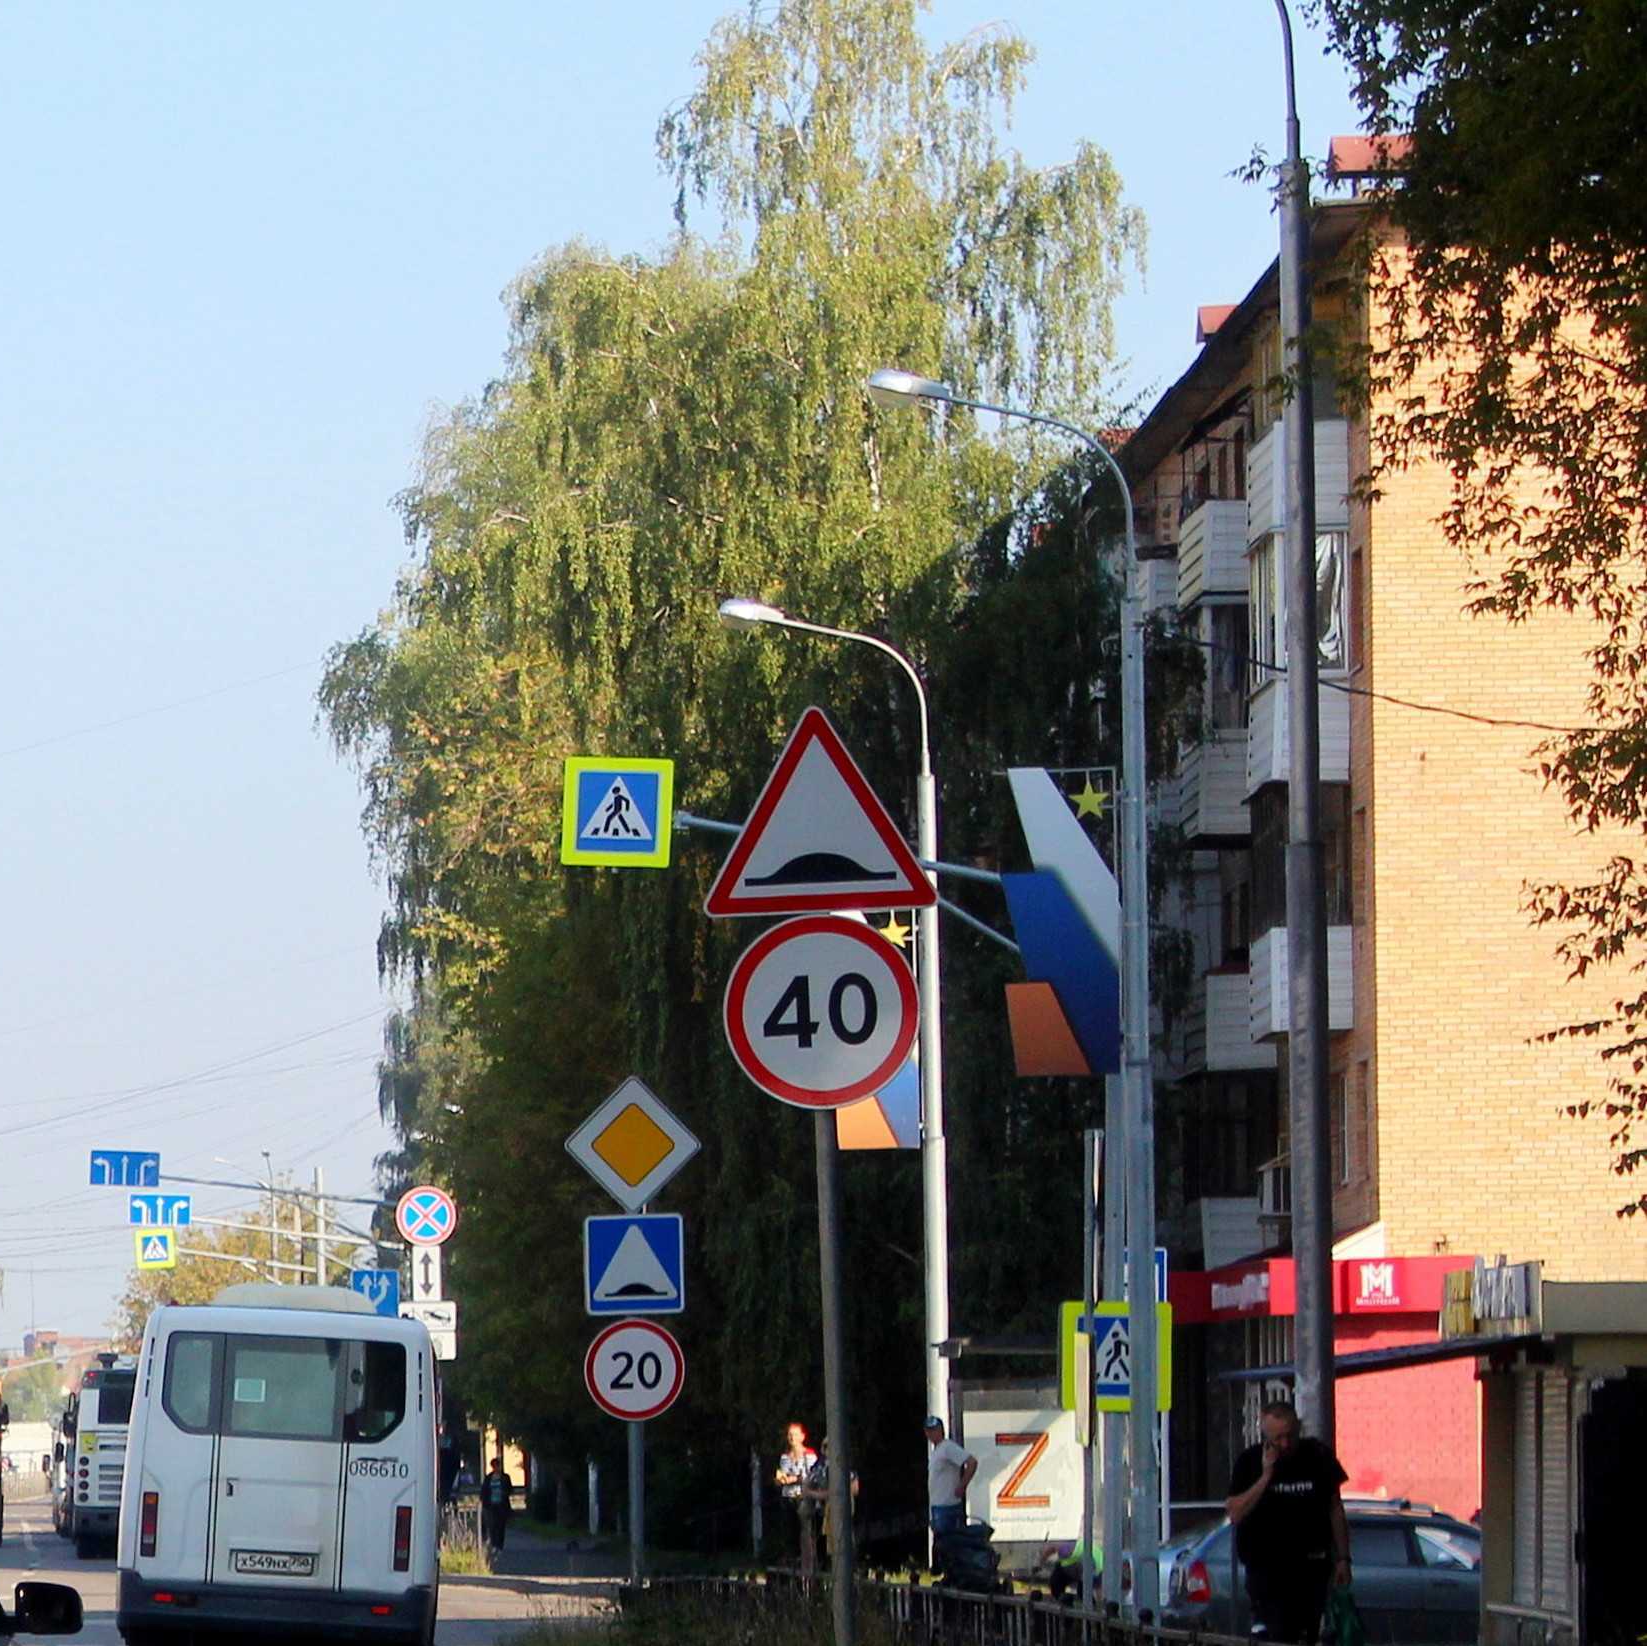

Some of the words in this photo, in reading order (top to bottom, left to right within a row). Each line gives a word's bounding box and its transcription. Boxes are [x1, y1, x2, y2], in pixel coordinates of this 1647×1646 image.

[762, 972, 879, 1049] 40
[610, 1351, 663, 1390] 20
[349, 1460, 410, 1479] 086610
[994, 1431, 1051, 1509] Z
